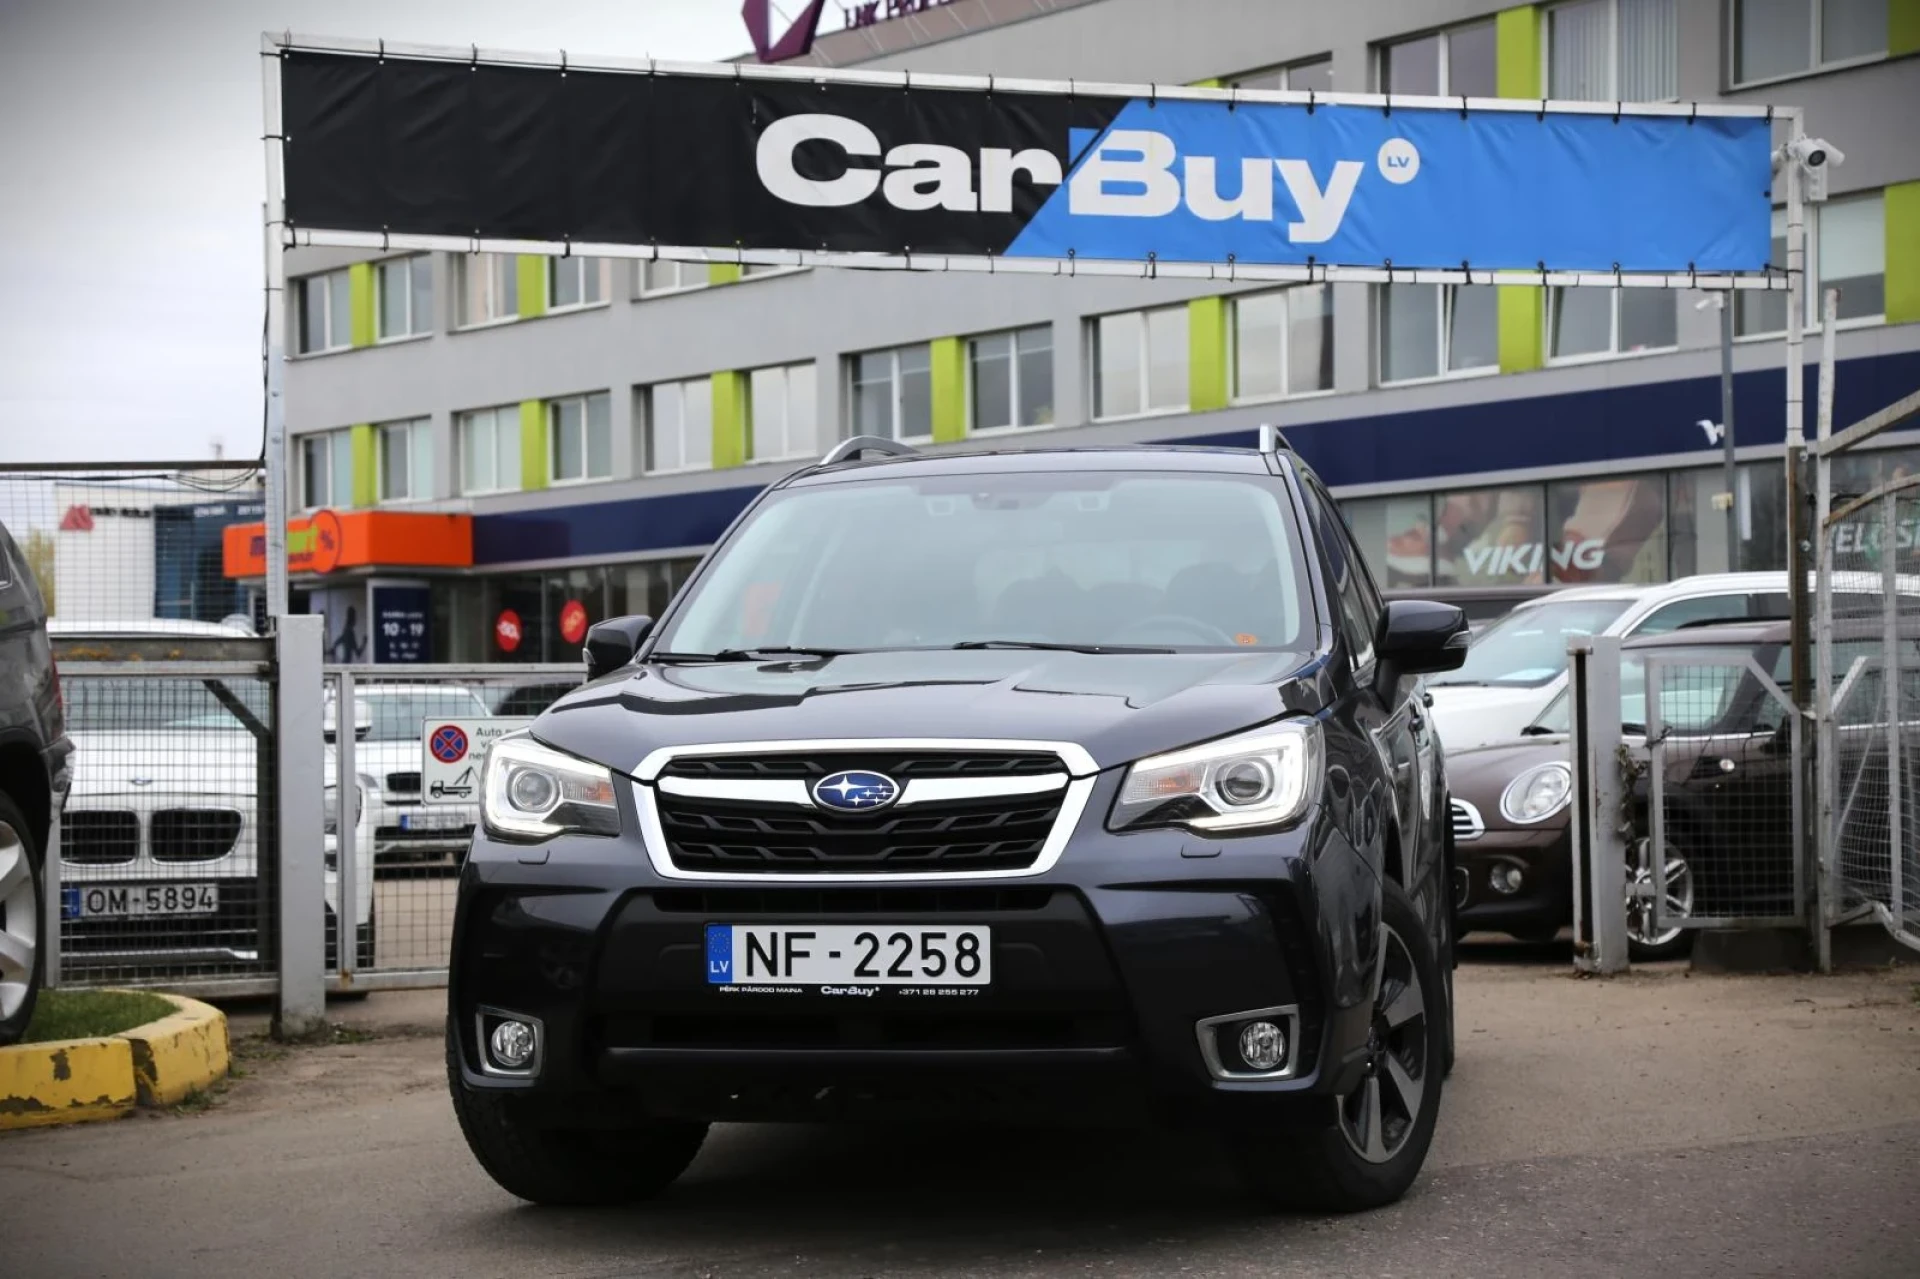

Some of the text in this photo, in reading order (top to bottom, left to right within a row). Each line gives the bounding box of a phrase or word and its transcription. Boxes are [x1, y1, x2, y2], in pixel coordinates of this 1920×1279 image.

[755, 113, 1410, 243] CarBuy LV
[1463, 540, 1605, 576] VIKING
[476, 727, 502, 737] Auto
[87, 887, 212, 913] OM-5894
[710, 960, 729, 973] LV
[820, 985, 875, 996] CarBuy
